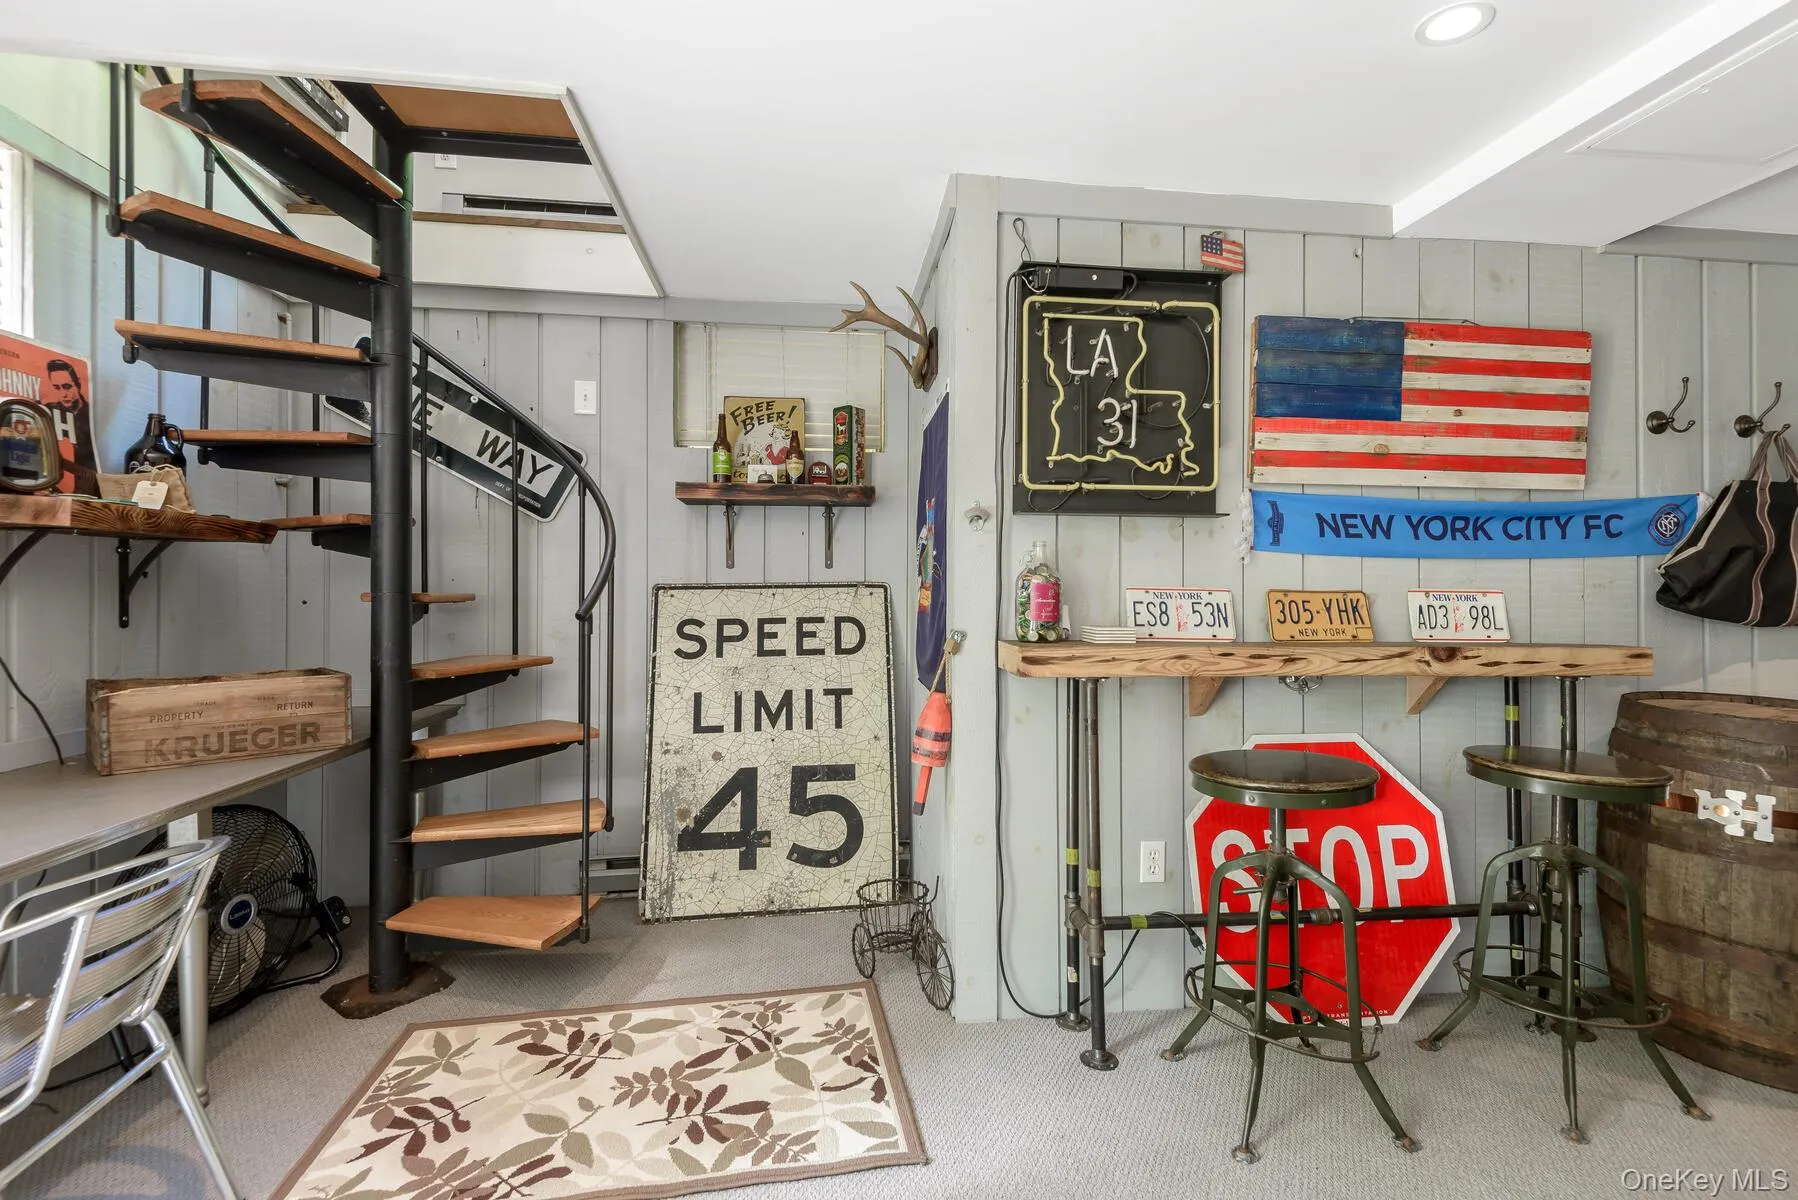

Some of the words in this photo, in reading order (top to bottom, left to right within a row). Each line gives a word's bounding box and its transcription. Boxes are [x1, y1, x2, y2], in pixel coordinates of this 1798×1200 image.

[1066, 325, 1119, 378] LA
[0, 367, 41, 400] HNNY
[729, 400, 776, 427] FREE
[741, 405, 798, 436] BEER!
[1097, 397, 1138, 449] 31
[476, 429, 554, 485] WAY
[1315, 512, 1395, 540] NEW
[1405, 514, 1494, 541] YORK
[1501, 513, 1575, 541] CITY
[1583, 513, 1624, 540] FC
[1152, 591, 1174, 600] NEW
[1177, 591, 1203, 600] YORK
[1432, 593, 1452, 602] NEW
[1454, 593, 1478, 602] YORK
[1132, 601, 1170, 627] ES8
[1191, 601, 1229, 628] 53N
[1418, 604, 1449, 630] AD3
[673, 616, 867, 660] SPEED
[1298, 628, 1318, 637] NEW
[1322, 628, 1347, 637] YORK
[150, 711, 204, 724] PROPERTY
[276, 700, 313, 712] RETURN
[692, 687, 854, 734] LIMIT
[144, 721, 321, 764] KRUEGER
[676, 763, 865, 871] 45
